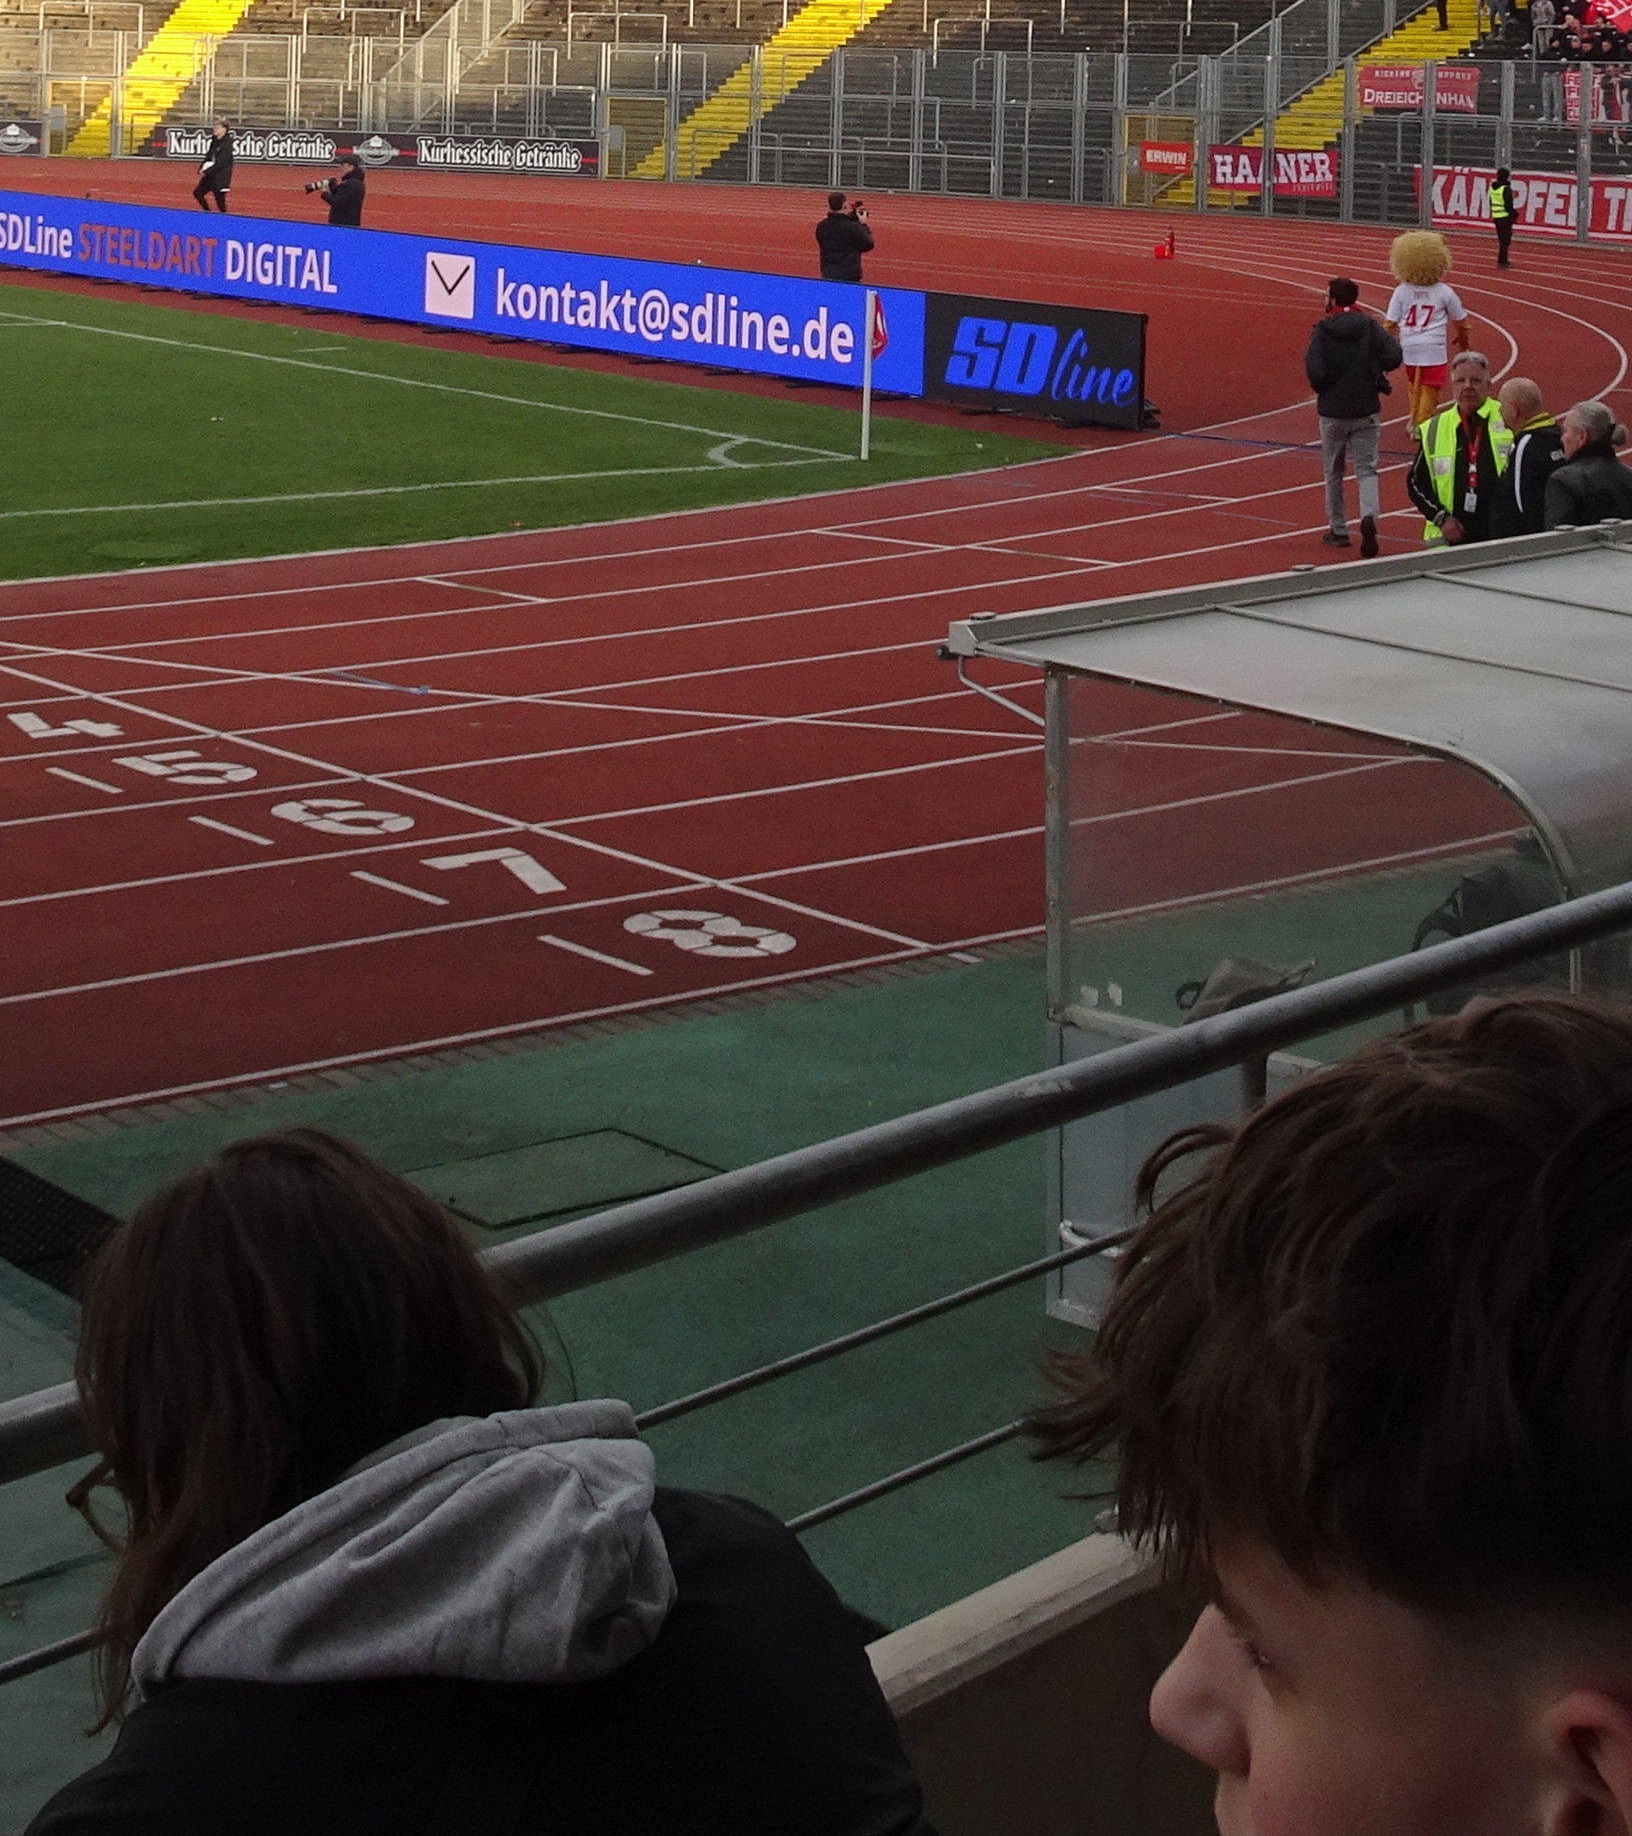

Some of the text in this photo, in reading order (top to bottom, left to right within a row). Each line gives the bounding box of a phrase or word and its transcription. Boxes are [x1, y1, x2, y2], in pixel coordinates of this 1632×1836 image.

[268, 133, 333, 159] Getränke
[420, 138, 580, 171] Kurhessische Getränke
[1146, 149, 1186, 164] ERWIN
[78, 223, 219, 278] STEELDART
[224, 239, 338, 294] DIGITAL
[496, 267, 855, 363] kontakt@sdline.de
[1404, 304, 1436, 328] 47
[7, 711, 124, 738] 4
[112, 750, 258, 785] 5
[270, 798, 415, 835] 6
[418, 846, 567, 894] 7
[622, 909, 797, 958] 8
